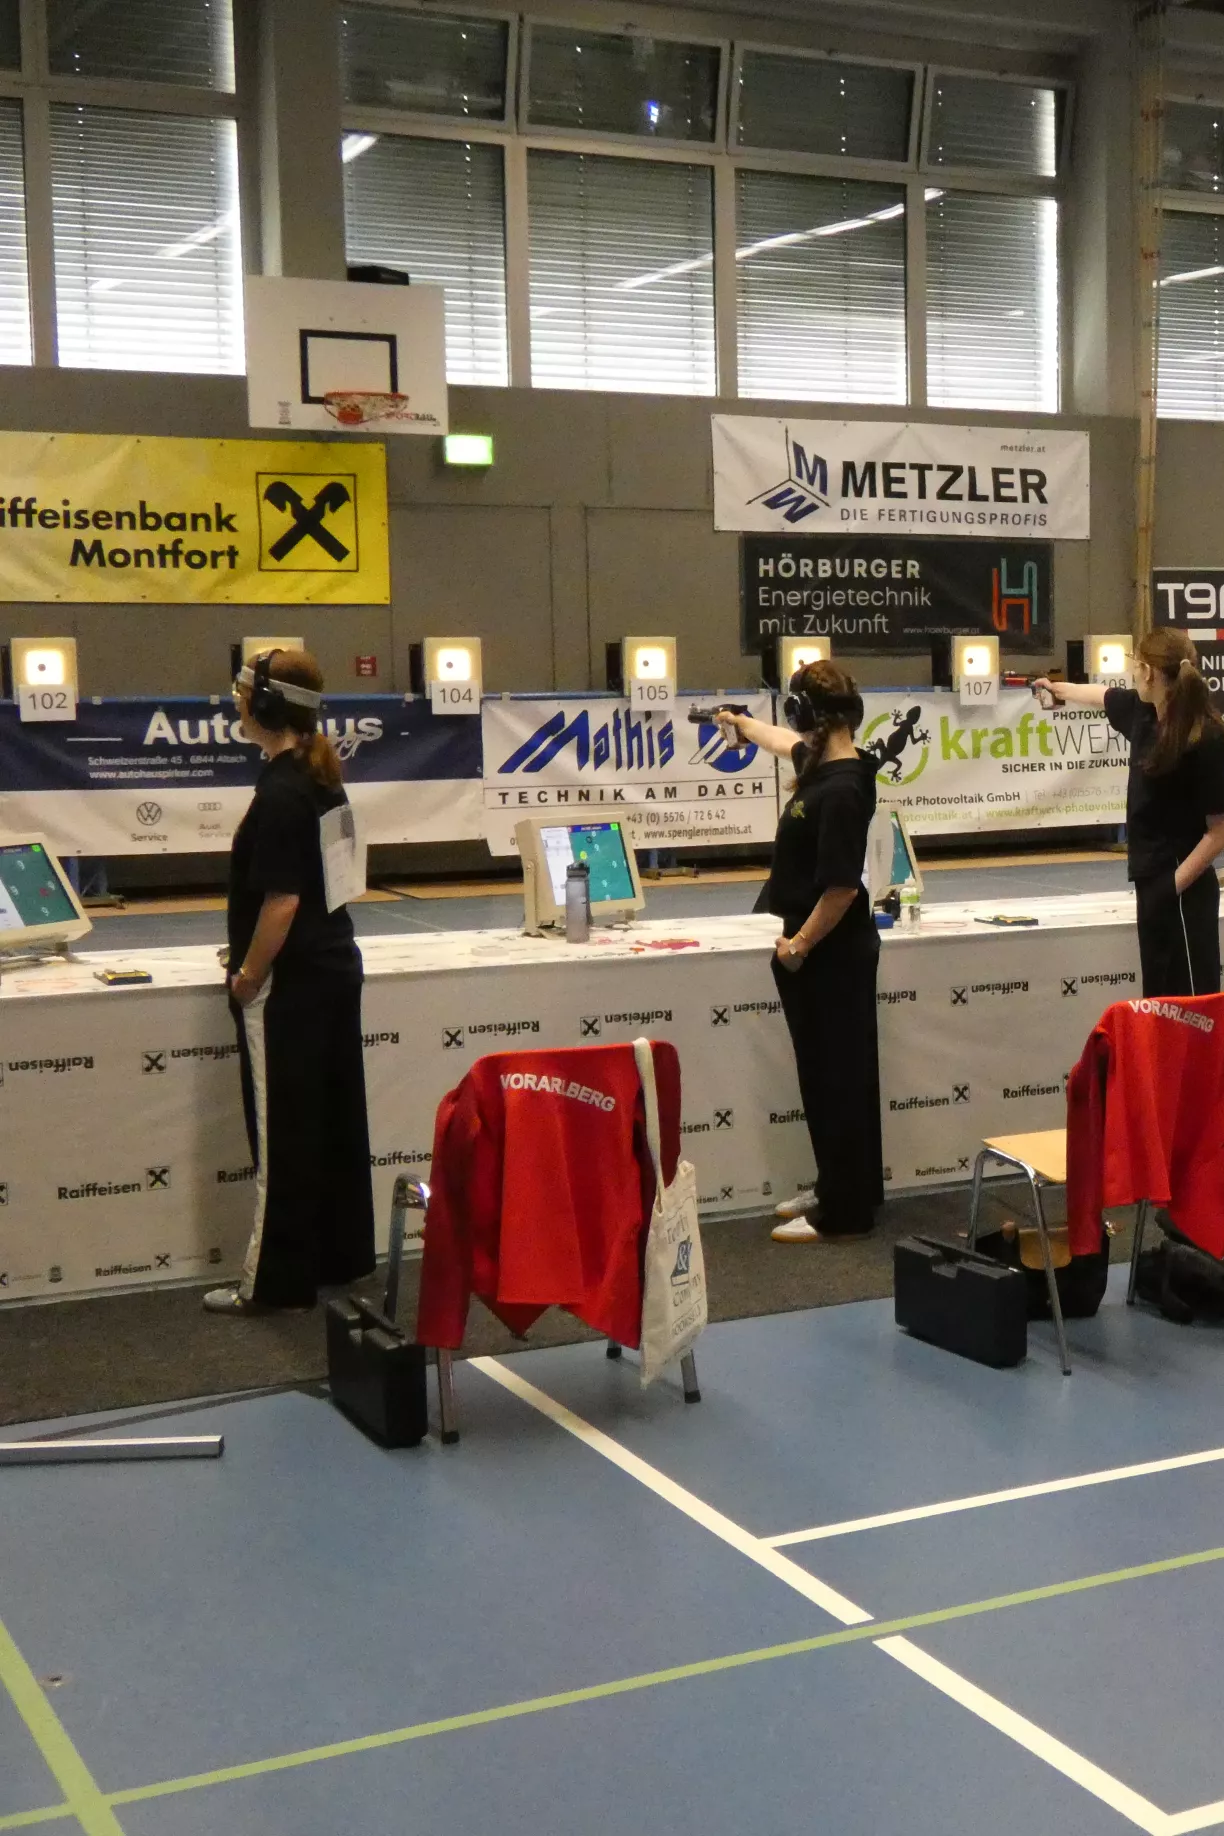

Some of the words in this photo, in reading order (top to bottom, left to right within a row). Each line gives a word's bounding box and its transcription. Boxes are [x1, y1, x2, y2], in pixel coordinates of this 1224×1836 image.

[841, 461, 1048, 504] METZLER
[840, 508, 868, 521] DIE
[878, 508, 1047, 526] FERTIGUNGSPROFIS
[70, 538, 238, 569] Montfort
[758, 553, 920, 579] HÖRBURGER
[758, 587, 932, 611] Energietechnik
[759, 614, 796, 634] mit
[803, 613, 890, 634] Zukunft
[439, 688, 474, 704] 104
[637, 686, 668, 701] 105
[964, 681, 992, 696] 107
[28, 692, 68, 710] 102
[1053, 710, 1107, 721] PHOTOVO
[143, 712, 383, 745] Autous
[498, 708, 674, 774] Mathis
[171, 756, 182, 764] 45
[1001, 763, 1046, 774] SICHER
[1050, 762, 1062, 771] IN
[1067, 760, 1085, 770] DIE
[499, 788, 625, 805] TECHNIK
[645, 787, 677, 800] AM
[698, 782, 764, 797] DACH
[916, 792, 984, 806] Photovoltaik
[986, 790, 1021, 803] GmbH
[626, 813, 643, 824] +43
[646, 811, 660, 824] (0)
[663, 810, 685, 823] 5576
[694, 810, 705, 821] 72
[707, 810, 713, 820] 6
[715, 809, 726, 820] 42
[131, 834, 168, 842] Service
[644, 824, 752, 840] www.spenglereimathis.at
[1081, 972, 1136, 986] Raiffeisen
[971, 980, 1029, 995] Raiffeisen
[604, 1009, 673, 1027] Raiffeisen
[1128, 999, 1214, 1033] VORARLBERG
[468, 1020, 540, 1036] Raiffeisen
[9, 1056, 94, 1073] Raiffeisen
[500, 1073, 616, 1113] VORARLBERG
[1003, 1083, 1060, 1099] Raiffeisen
[889, 1096, 949, 1111] Raiffeisen
[769, 1110, 806, 1124] Raiffe
[369, 1151, 432, 1167] Raiffeise
[217, 1166, 257, 1184] Raiff
[915, 1166, 956, 1177] Raiffeisen
[58, 1181, 141, 1200] Raiffeisen
[95, 1264, 151, 1277] Raiffeisen
